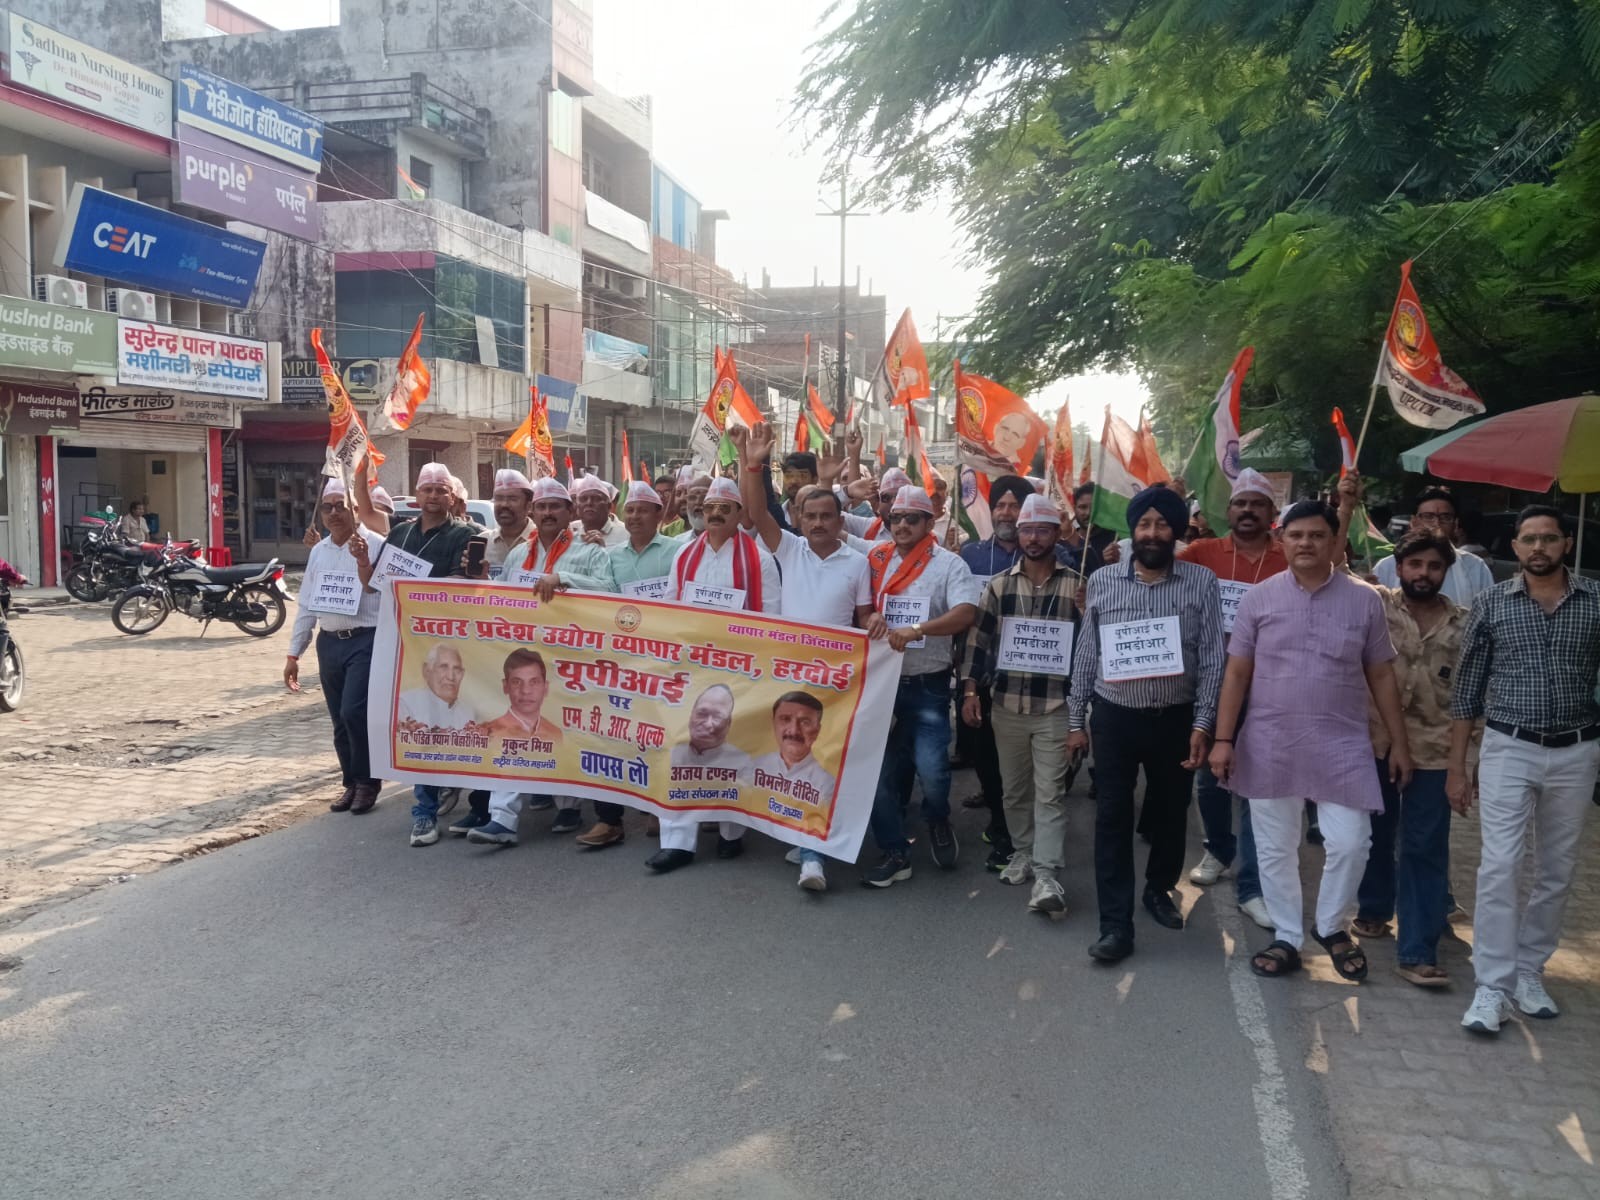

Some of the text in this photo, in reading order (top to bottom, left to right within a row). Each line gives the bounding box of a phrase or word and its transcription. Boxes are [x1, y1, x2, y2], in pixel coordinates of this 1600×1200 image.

[22, 22, 77, 63] Sadhna
[81, 52, 129, 88] Nursing
[132, 74, 164, 99] Home
[186, 155, 246, 191] purple
[275, 185, 306, 214] पर्पल
[93, 222, 157, 259] CEAT
[53, 313, 94, 335] Bank
[51, 334, 74, 356] बैंक
[124, 324, 263, 363] सुरेन्द्र पाल पाठक
[126, 349, 190, 374] मशीनरी
[208, 360, 261, 382] स्पेयर्स
[18, 393, 77, 408] IndusInd Bank
[81, 386, 130, 411] फील्ड
[408, 591, 538, 609] व्यापारी एकता जिंदाबाद
[723, 592, 733, 601] पर
[912, 602, 922, 610] पर
[727, 623, 853, 652] व्यापार मंडल जिंदाबाद
[1015, 621, 1060, 636] यूपीआई पर
[1115, 621, 1166, 639] यूपीआई पर
[411, 616, 853, 690] उत्तर प्रदेश उद्योग व्यापार मंडल, हरदोई
[1013, 635, 1060, 651] एमडीआर
[1115, 636, 1167, 656] एमडीआर
[1005, 650, 1064, 664] शुल्क वापस लो
[1109, 656, 1132, 671] शुल्क
[1134, 654, 1159, 665] वापस
[1162, 650, 1176, 661] लो
[555, 659, 690, 703] यूपीआई
[608, 694, 632, 710] पर
[562, 705, 665, 752] एम. डी. आर. शुल्क
[502, 738, 553, 756] मुकुन्द मिश्रा
[581, 751, 649, 786] वापस लो
[671, 766, 737, 782] अजय टण्डन
[668, 787, 689, 801] प्रदेश
[722, 788, 738, 800] मंत्री
[793, 779, 820, 806] दीक्षित
